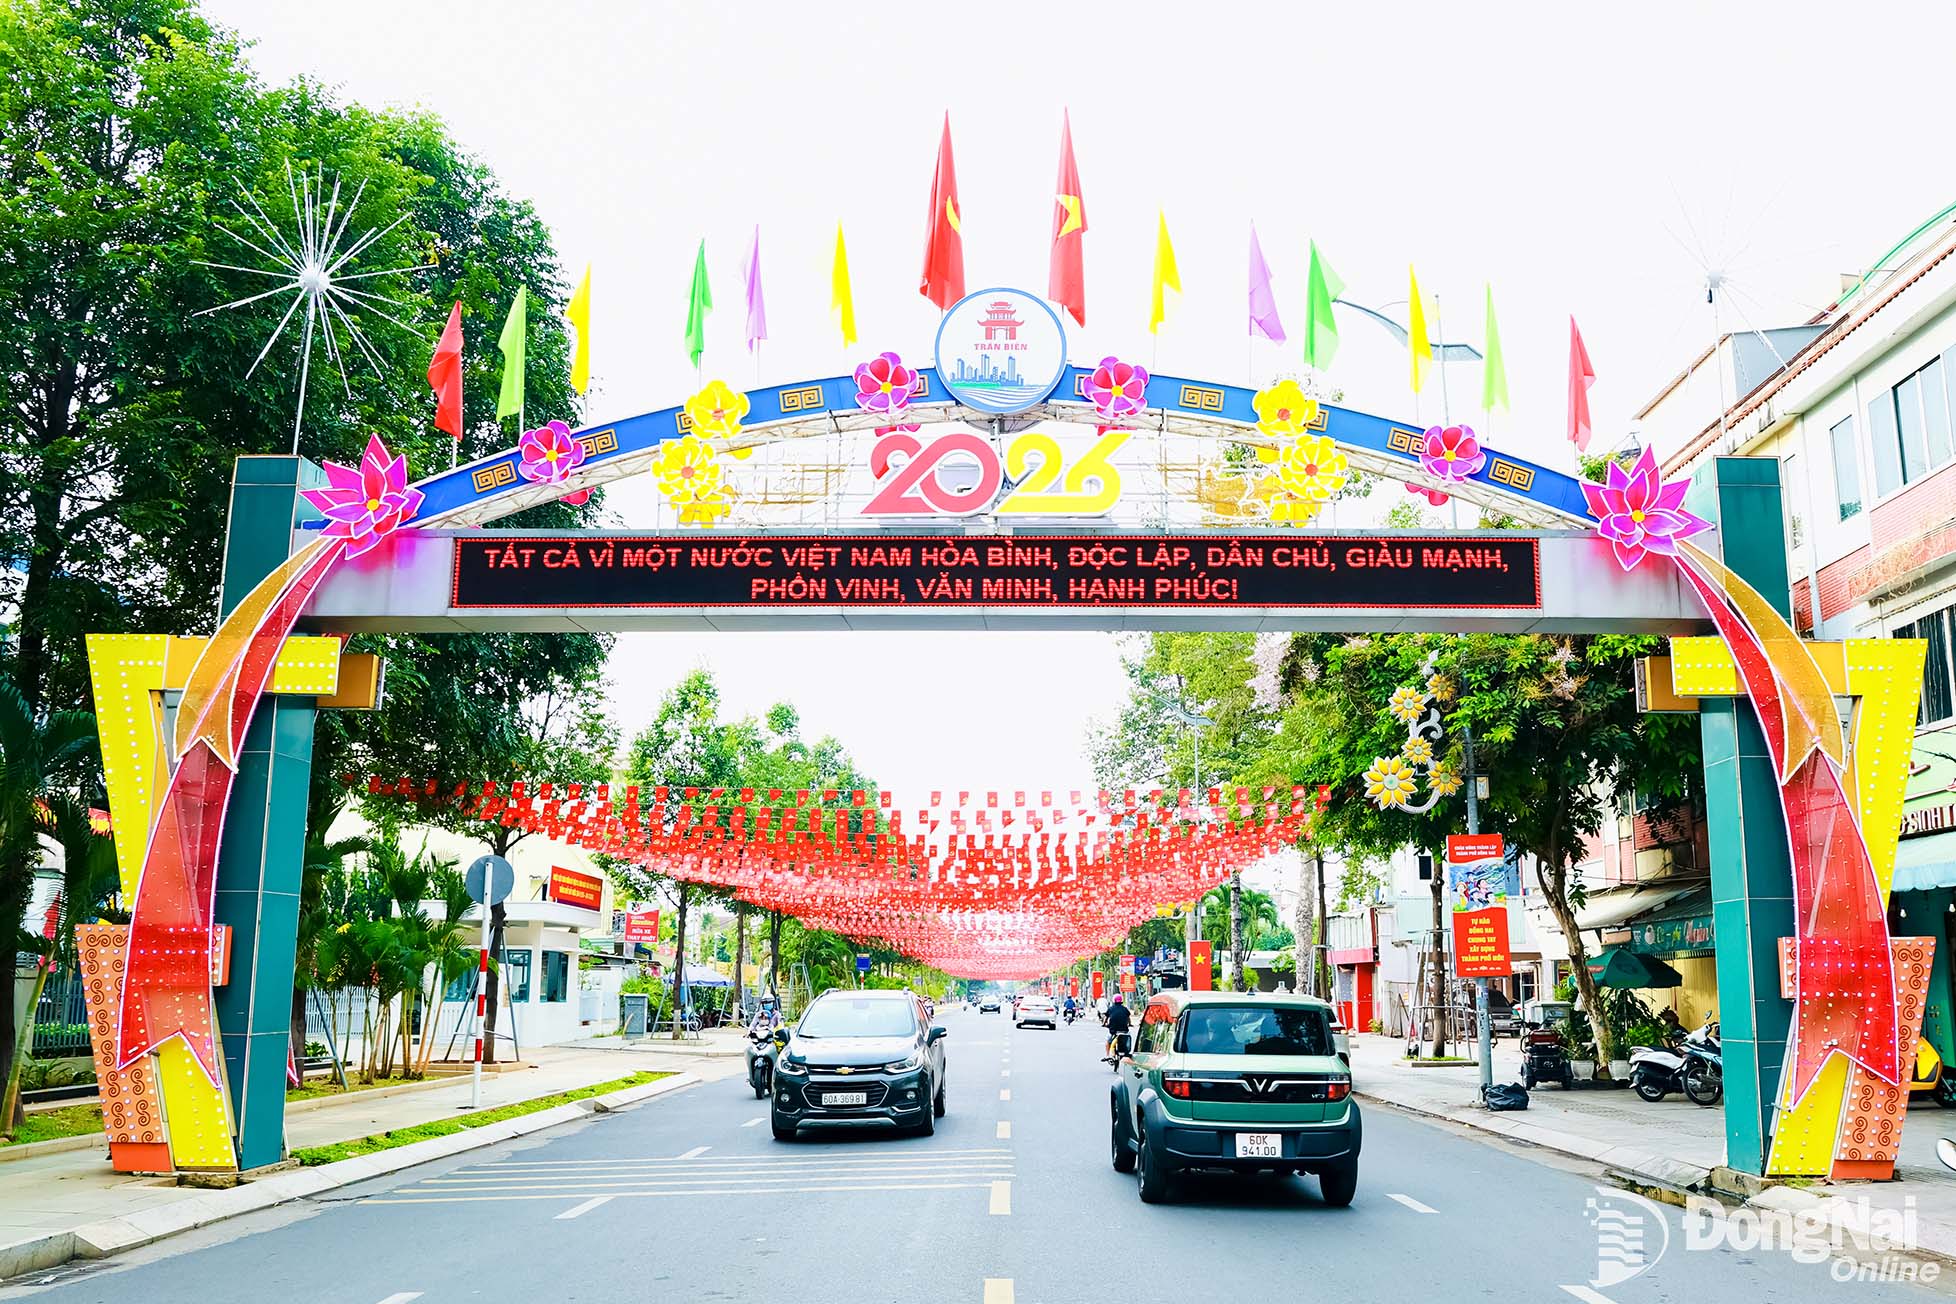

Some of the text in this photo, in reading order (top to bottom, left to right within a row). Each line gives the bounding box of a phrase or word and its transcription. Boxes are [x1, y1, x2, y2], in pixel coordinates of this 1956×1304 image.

[861, 433, 1131, 514] 2026
[484, 540, 1509, 573] TẤT CẢ VÌ MỘT NƯỚC VIỆT NAM HÒA BÌNH, ĐỘC LẬP, DÂN CHỦ, GIÀU MẠNH,
[834, 578, 906, 603] VINH,
[915, 571, 972, 599] VĂN
[982, 578, 1058, 603] MINH,
[1069, 578, 1145, 603] HẠNH
[1155, 571, 1239, 600] PHÚC!
[1249, 1135, 1269, 1146] 60K
